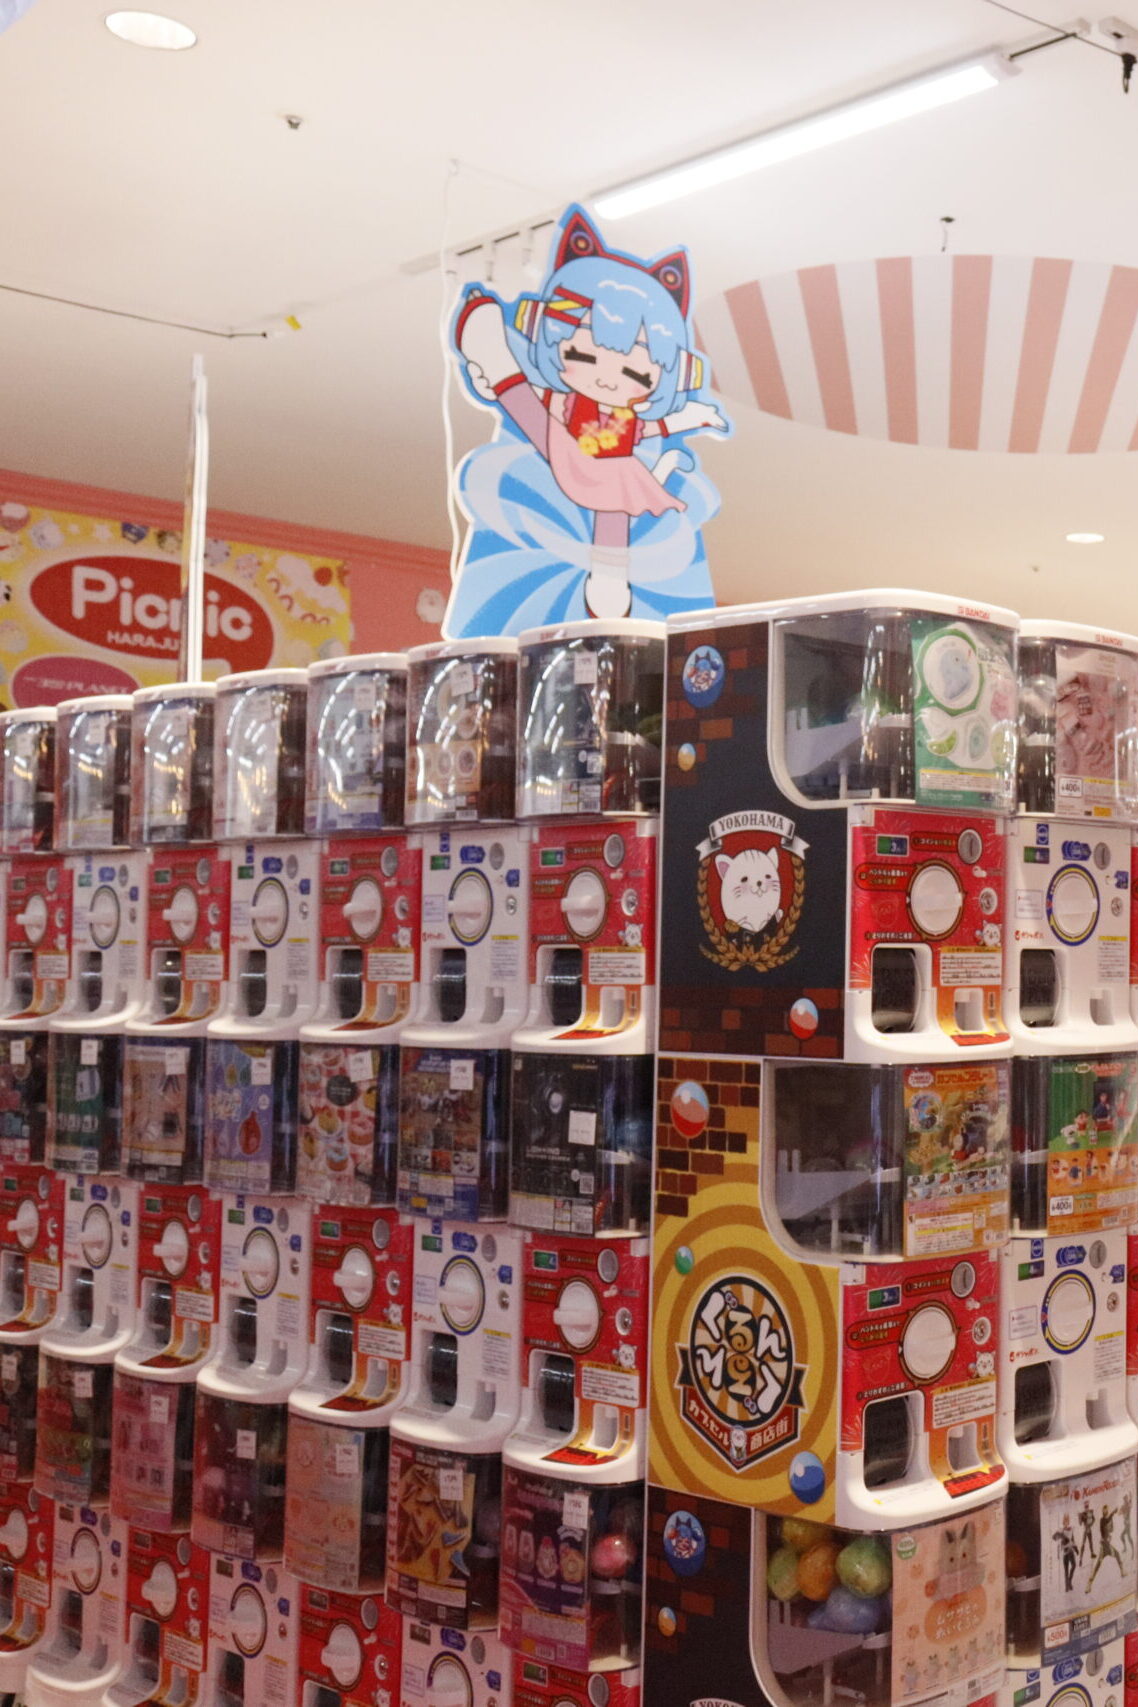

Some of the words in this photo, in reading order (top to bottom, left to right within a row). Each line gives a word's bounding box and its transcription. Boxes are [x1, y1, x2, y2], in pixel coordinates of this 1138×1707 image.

[107, 630, 182, 651] HARAJU
[718, 814, 784, 832] YOKOHAMA
[688, 1399, 730, 1447] カプセル
[750, 1416, 790, 1451] 商店街
